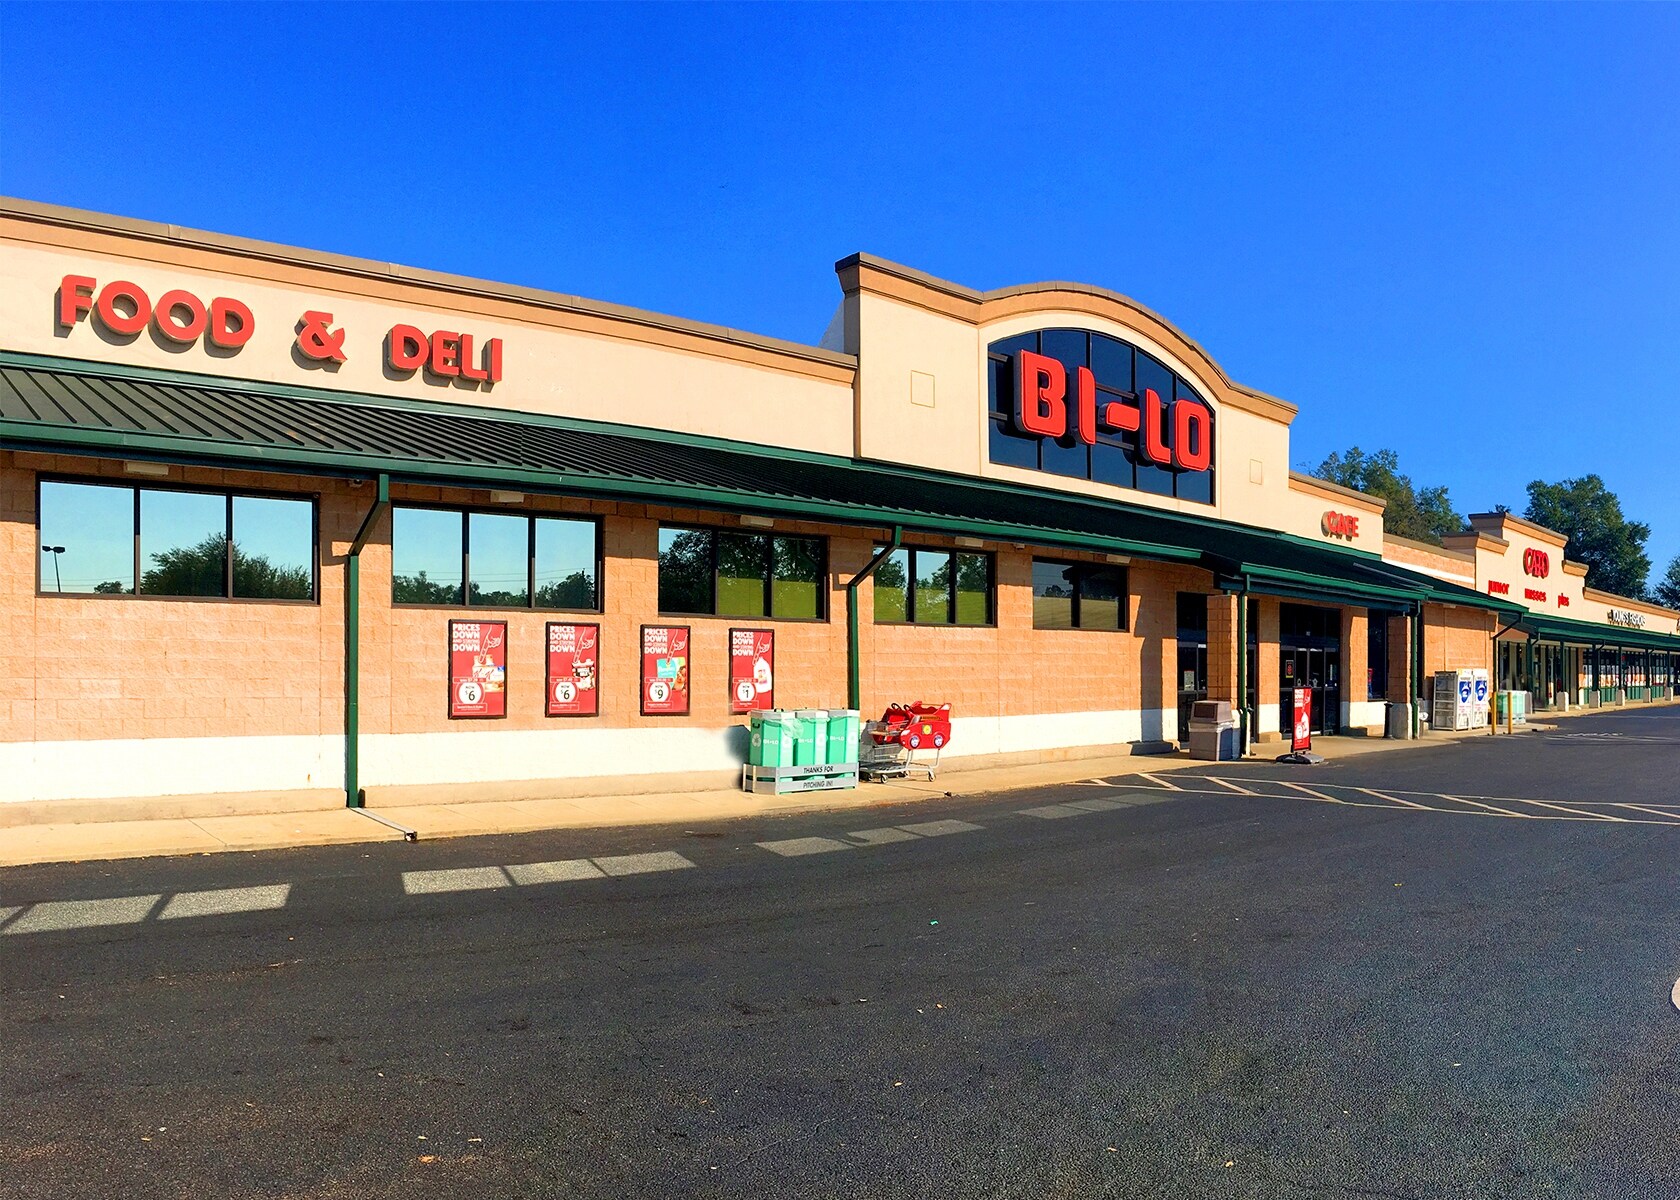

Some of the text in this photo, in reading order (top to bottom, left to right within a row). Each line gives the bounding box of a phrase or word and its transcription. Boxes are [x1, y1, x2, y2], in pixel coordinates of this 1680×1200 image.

[60, 274, 502, 384] FOOD & DELI
[1017, 349, 1212, 472] BI-LO
[1326, 511, 1359, 538] CAFE
[1524, 547, 1549, 578] CATO
